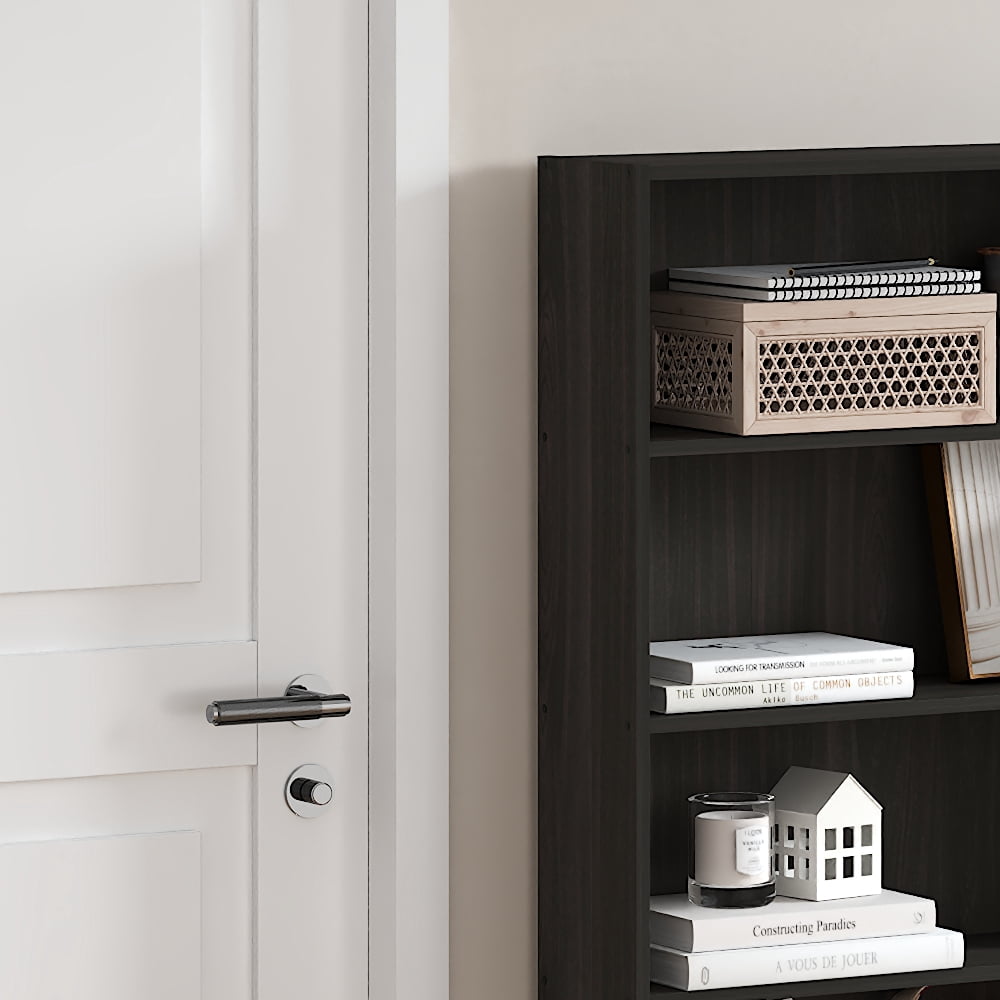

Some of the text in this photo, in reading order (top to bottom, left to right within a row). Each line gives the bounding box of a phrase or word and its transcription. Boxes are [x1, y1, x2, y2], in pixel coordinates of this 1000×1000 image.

[715, 663, 744, 674] LOOKING
[745, 662, 758, 672] FOR
[759, 660, 805, 672] TRANSMISSION
[676, 675, 903, 699] THE UNCOMMON LIFE OF COMMON OBJECTS
[763, 696, 786, 705] Akiko
[753, 922, 814, 937] Constructing
[788, 956, 818, 972] VOUS
[822, 955, 837, 969] DE
[841, 952, 878, 970] JOUER
